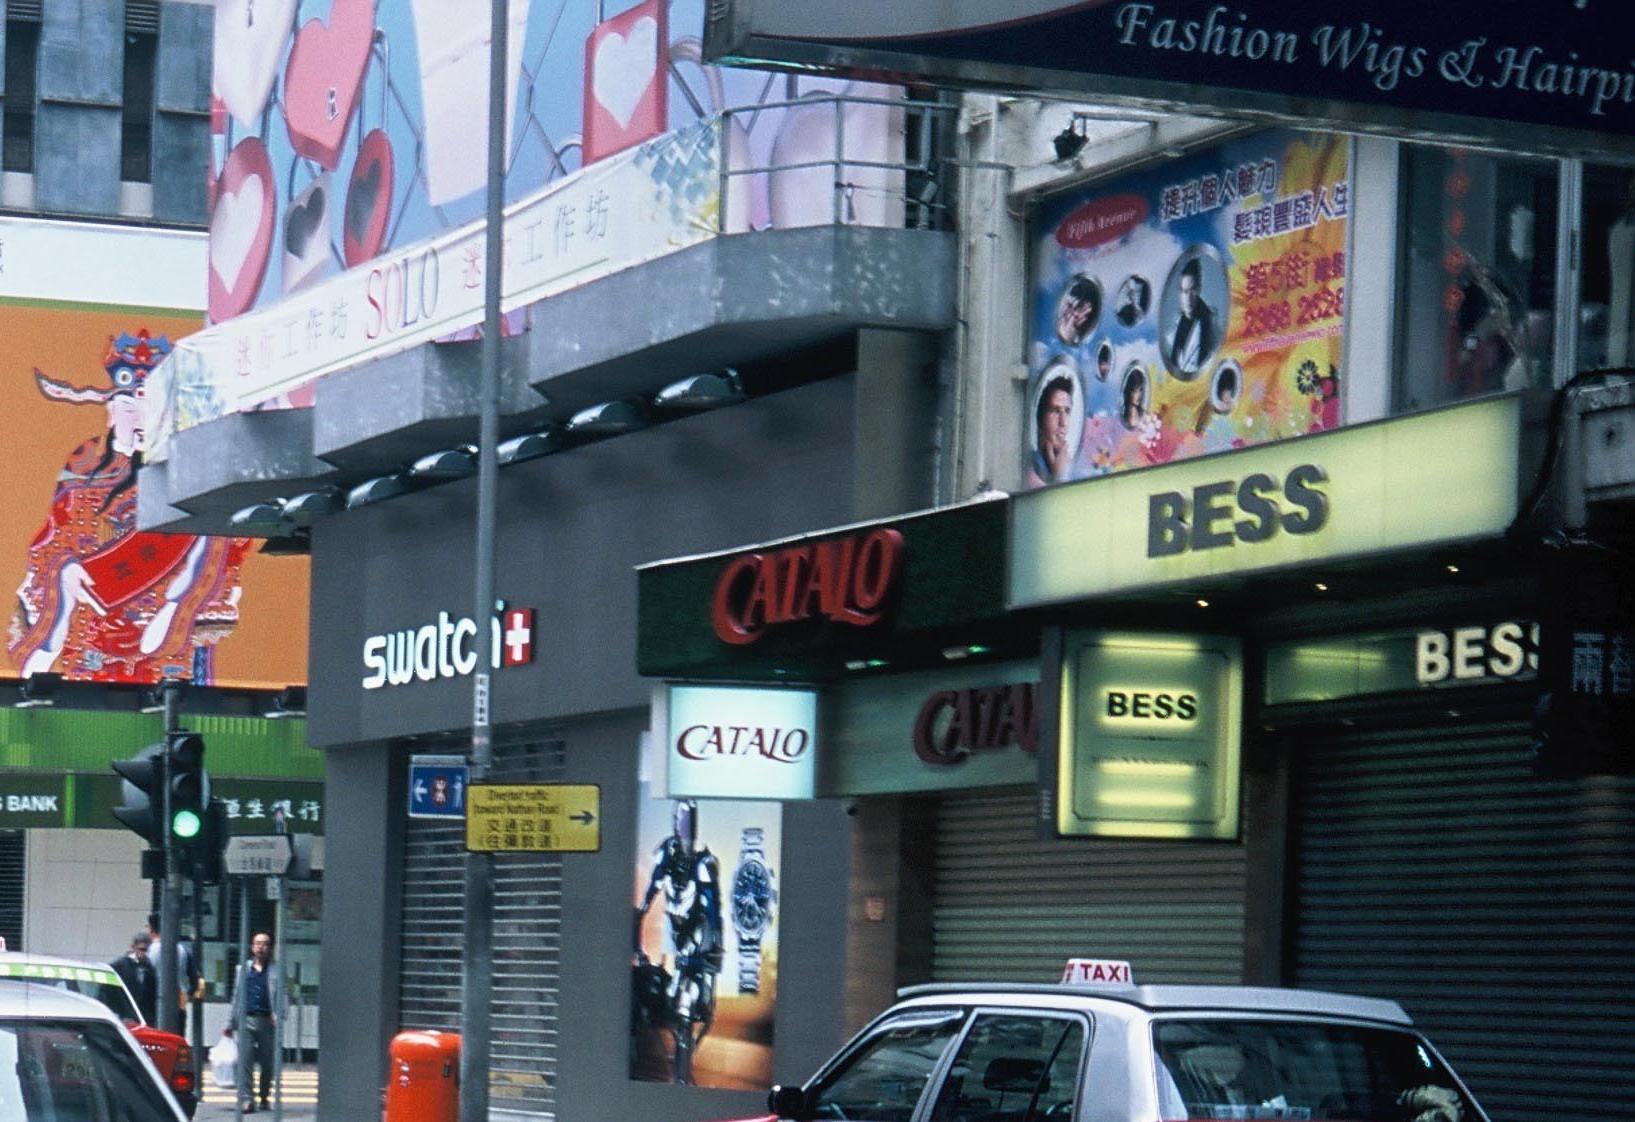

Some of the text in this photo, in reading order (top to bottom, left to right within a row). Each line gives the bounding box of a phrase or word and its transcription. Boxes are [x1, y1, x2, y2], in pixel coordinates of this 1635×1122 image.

[1116, 3, 1299, 63] Fashion
[1311, 23, 1428, 90] Wigs
[1438, 36, 1486, 87] &
[1067, 209, 1138, 240] Fifth Avenue
[367, 247, 440, 340] SOLO
[460, 189, 609, 290] 迷工作坊
[1147, 464, 1332, 559] BESS
[712, 529, 906, 646] CATALO
[1107, 692, 1198, 721] BESS
[676, 724, 810, 764] CATALO
[7, 795, 59, 812] BANK
[1080, 964, 1129, 982] TAXI
